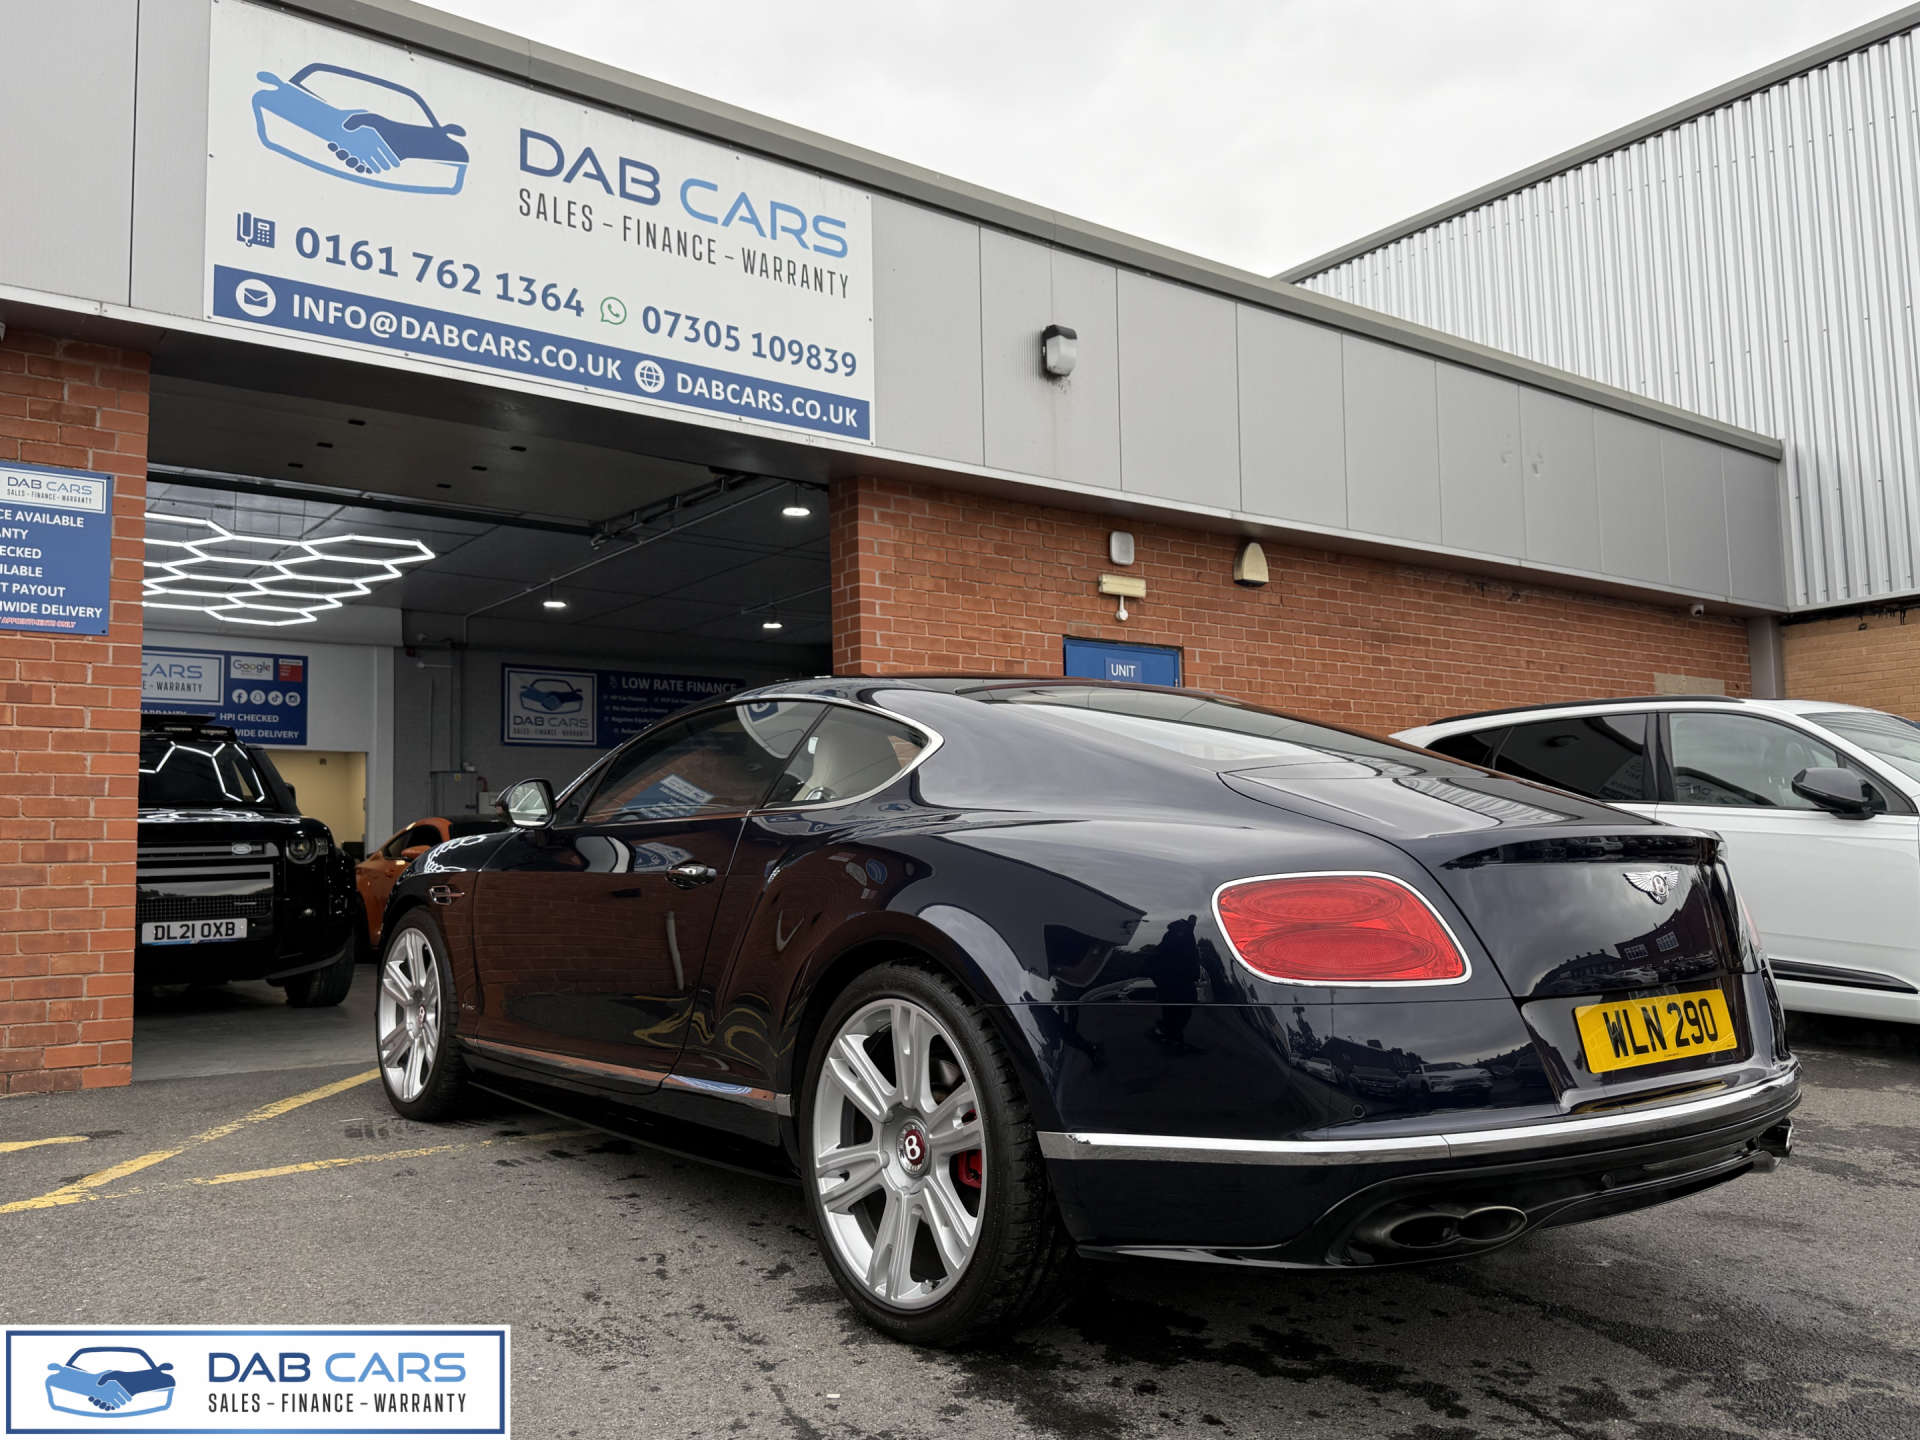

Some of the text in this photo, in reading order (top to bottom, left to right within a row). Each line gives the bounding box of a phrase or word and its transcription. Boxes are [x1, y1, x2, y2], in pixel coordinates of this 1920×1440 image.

[520, 127, 849, 259] DAB CARS
[519, 188, 593, 232] SALES
[623, 215, 716, 265] FINANCE
[741, 247, 849, 299] WARRANTY
[295, 226, 585, 318] 0161 762 1364
[292, 293, 622, 381] INFO@DABCARS.CO.UK
[642, 305, 857, 377] 07305 109839
[676, 372, 858, 428] DABCARS.CO.UK
[7, 476, 92, 496] DAB CARS
[15, 510, 85, 528] AVAILABLE
[12, 583, 66, 598] PAYOUT
[41, 602, 103, 619] DELIVERY
[232, 659, 271, 674] Google
[1111, 663, 1136, 678] UNIT
[156, 681, 203, 693] WARRANTY
[621, 676, 651, 689] LOW
[653, 678, 684, 692] RATE
[237, 713, 280, 723] CHECKED
[513, 715, 589, 729] DAB CARS
[258, 730, 299, 739] DELIVERY
[153, 921, 235, 941] DL21 OXB
[1603, 998, 1719, 1058] WLN 290
